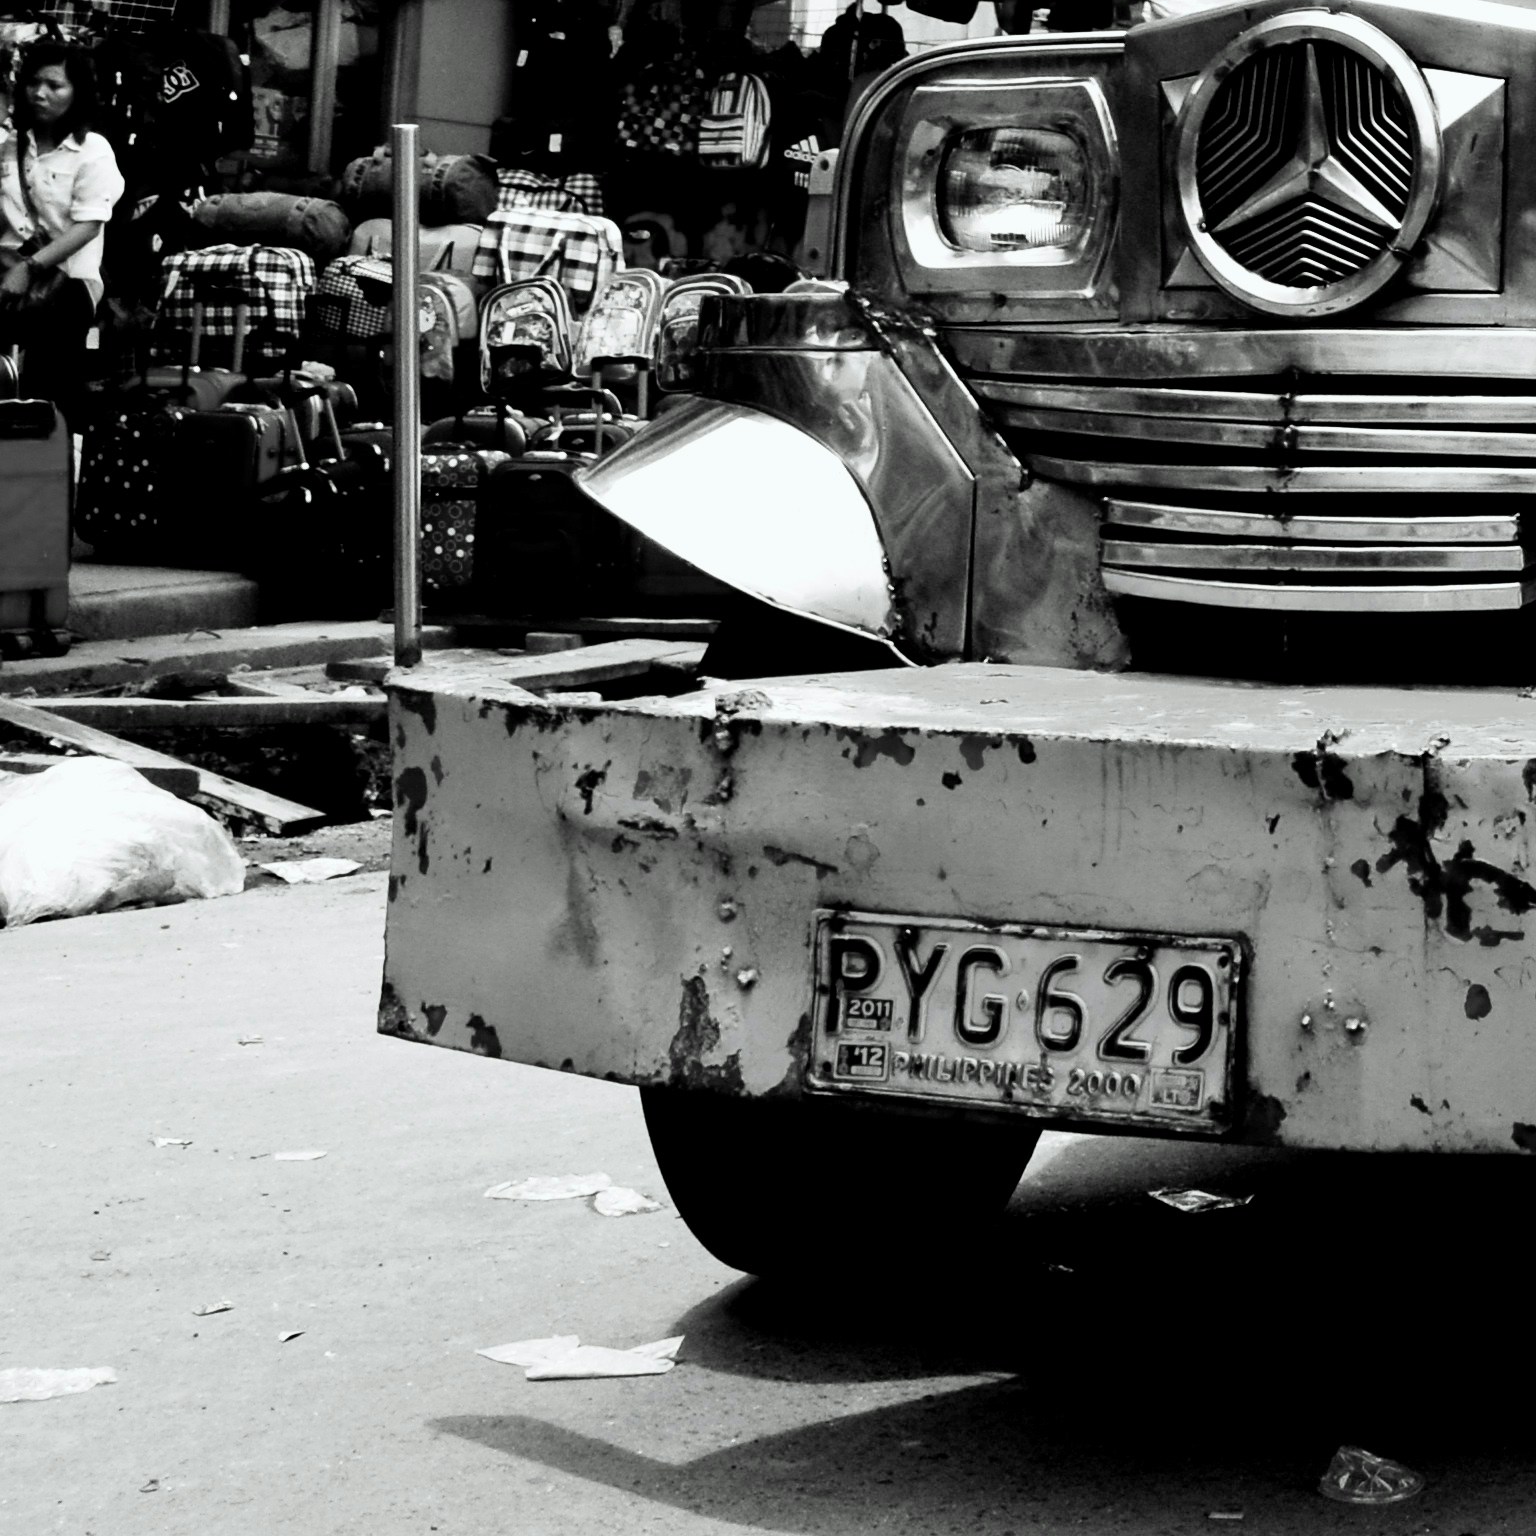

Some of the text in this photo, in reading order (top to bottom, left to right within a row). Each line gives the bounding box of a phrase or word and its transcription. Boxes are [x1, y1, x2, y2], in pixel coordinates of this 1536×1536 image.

[849, 999, 891, 1017] 2011
[892, 1051, 1143, 1098] PHILIPPINES 2000
